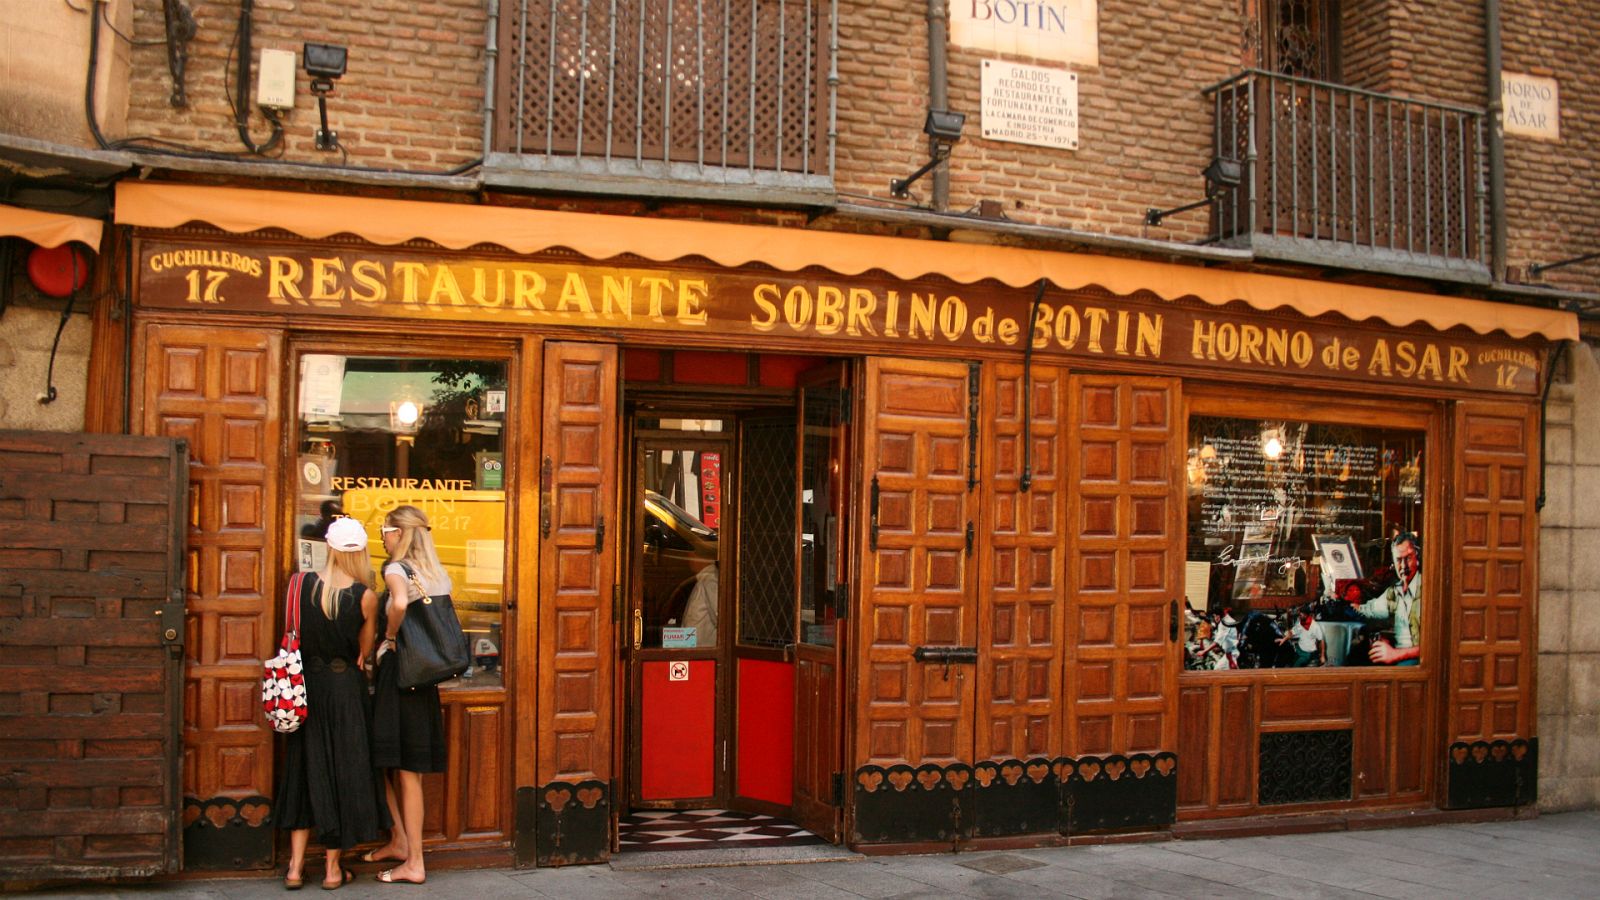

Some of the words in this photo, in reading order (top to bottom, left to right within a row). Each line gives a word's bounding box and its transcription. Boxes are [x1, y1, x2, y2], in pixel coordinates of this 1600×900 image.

[994, 88, 1053, 105] RESTAURANTE
[1056, 97, 1068, 106] EN
[1040, 83, 1061, 95] ESTE
[1502, 80, 1552, 101] HORNO
[1520, 100, 1532, 109] DE
[1028, 115, 1037, 123] DE
[1038, 117, 1076, 128] COMERCIO
[1507, 105, 1548, 129] ASAR
[1013, 122, 1055, 134] INDUSTRIA
[150, 249, 263, 278] CUCHILLEROS
[267, 255, 709, 325] RESTAURANTE
[750, 283, 968, 342] SOBRINO
[971, 306, 1021, 345] de
[1029, 302, 1164, 358] BOTIN
[1190, 318, 1314, 368] HORNO
[1321, 336, 1361, 371] de
[1367, 338, 1471, 384] ASAR
[1496, 364, 1520, 390] 17
[330, 476, 473, 491] RESTAURANTE
[351, 493, 455, 513] BOTIN
